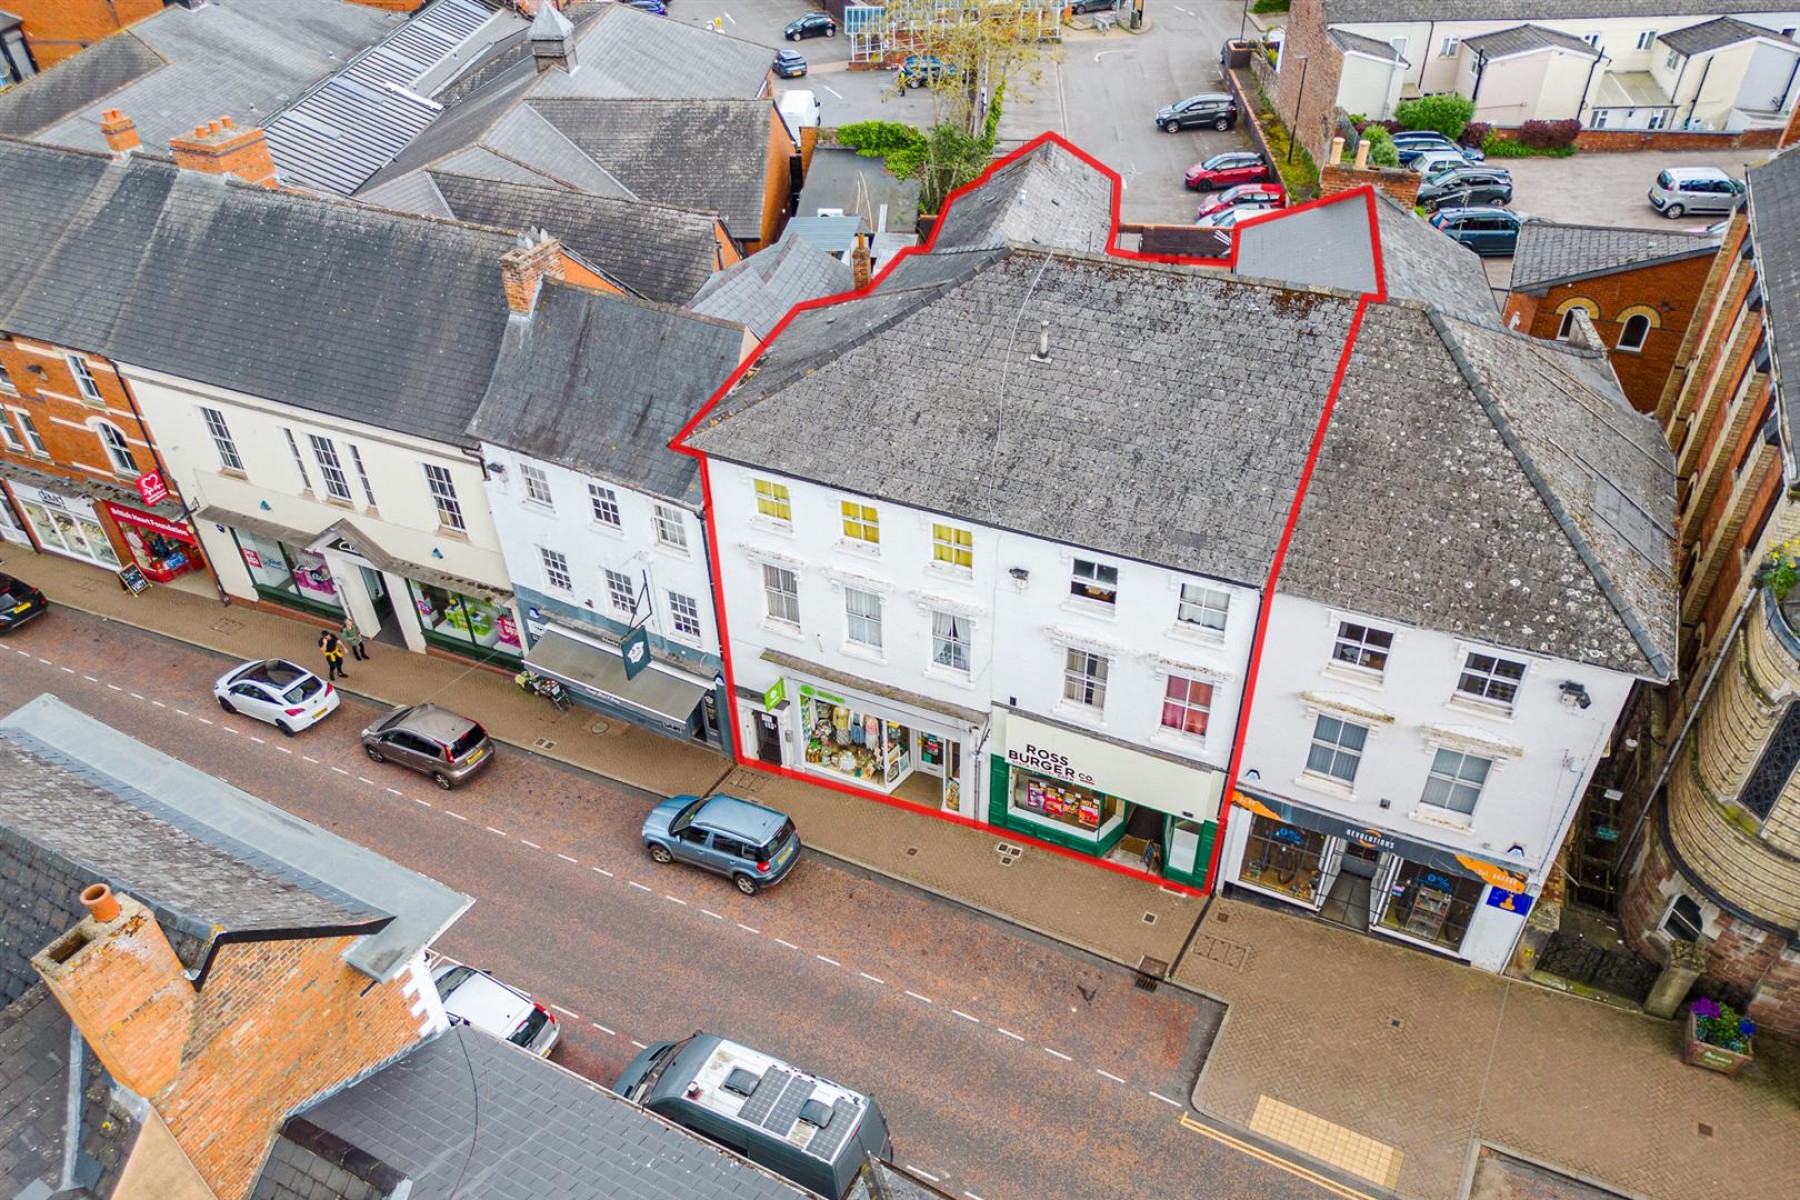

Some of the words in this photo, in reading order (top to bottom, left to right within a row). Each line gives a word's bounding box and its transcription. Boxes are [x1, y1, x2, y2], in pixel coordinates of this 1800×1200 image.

[1008, 749, 1076, 778] BURGER
[1026, 744, 1069, 766] ROSS
[1346, 828, 1395, 849] REVOLUTIONS
